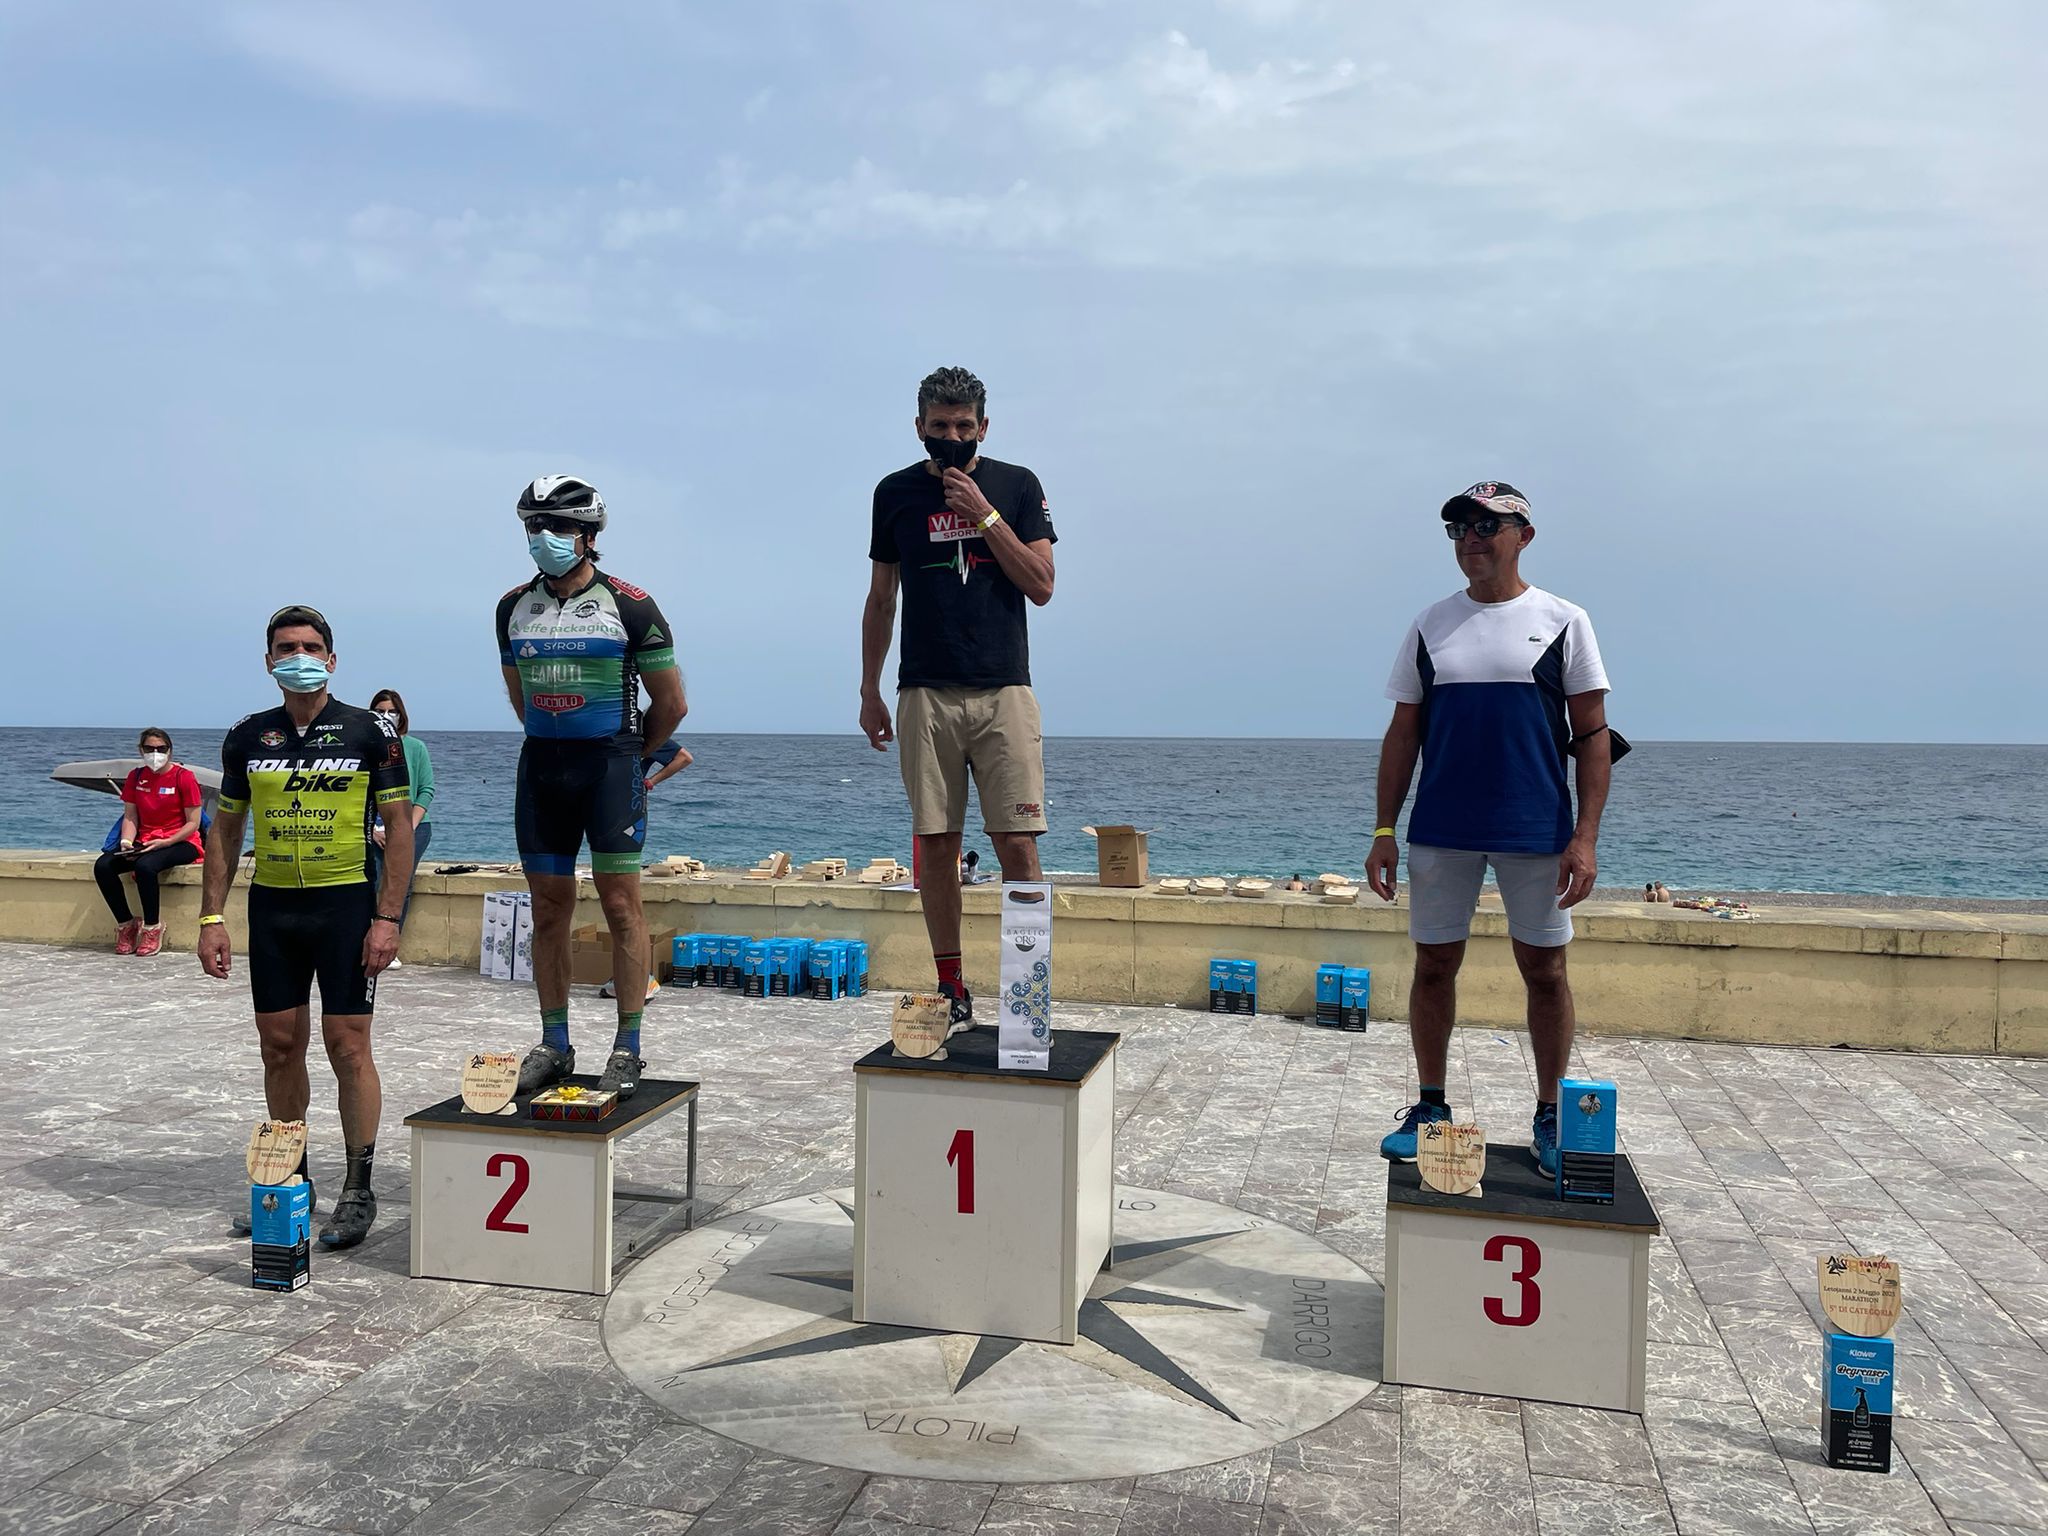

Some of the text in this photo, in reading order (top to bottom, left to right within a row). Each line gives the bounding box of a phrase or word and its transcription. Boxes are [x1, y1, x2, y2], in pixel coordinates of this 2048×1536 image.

[931, 514, 972, 532] WH
[943, 529, 978, 540] SPORT
[522, 623, 619, 637] effe packaging
[543, 641, 586, 651] SYROB
[246, 758, 361, 773] ROLLING
[265, 808, 337, 821] ecoenergy
[1006, 929, 1046, 937] BAGLIO
[1015, 935, 1036, 945] ORO
[946, 1129, 974, 1214] 1
[1440, 1167, 1478, 1177] CATEGORIA
[485, 1153, 530, 1234] 2
[1483, 1235, 1542, 1327] 3
[1841, 1294, 1880, 1304] MARATHON
[1858, 1288, 1880, 1297] Maggio
[1838, 1305, 1848, 1313] DI
[1849, 1306, 1894, 1317] CATEGORIA
[1292, 1278, 1332, 1359] D'ARRIGO
[1836, 1364, 1890, 1379] Degreaser
[654, 1375, 687, 1389] N
[863, 1411, 1020, 1446] PILOTA
